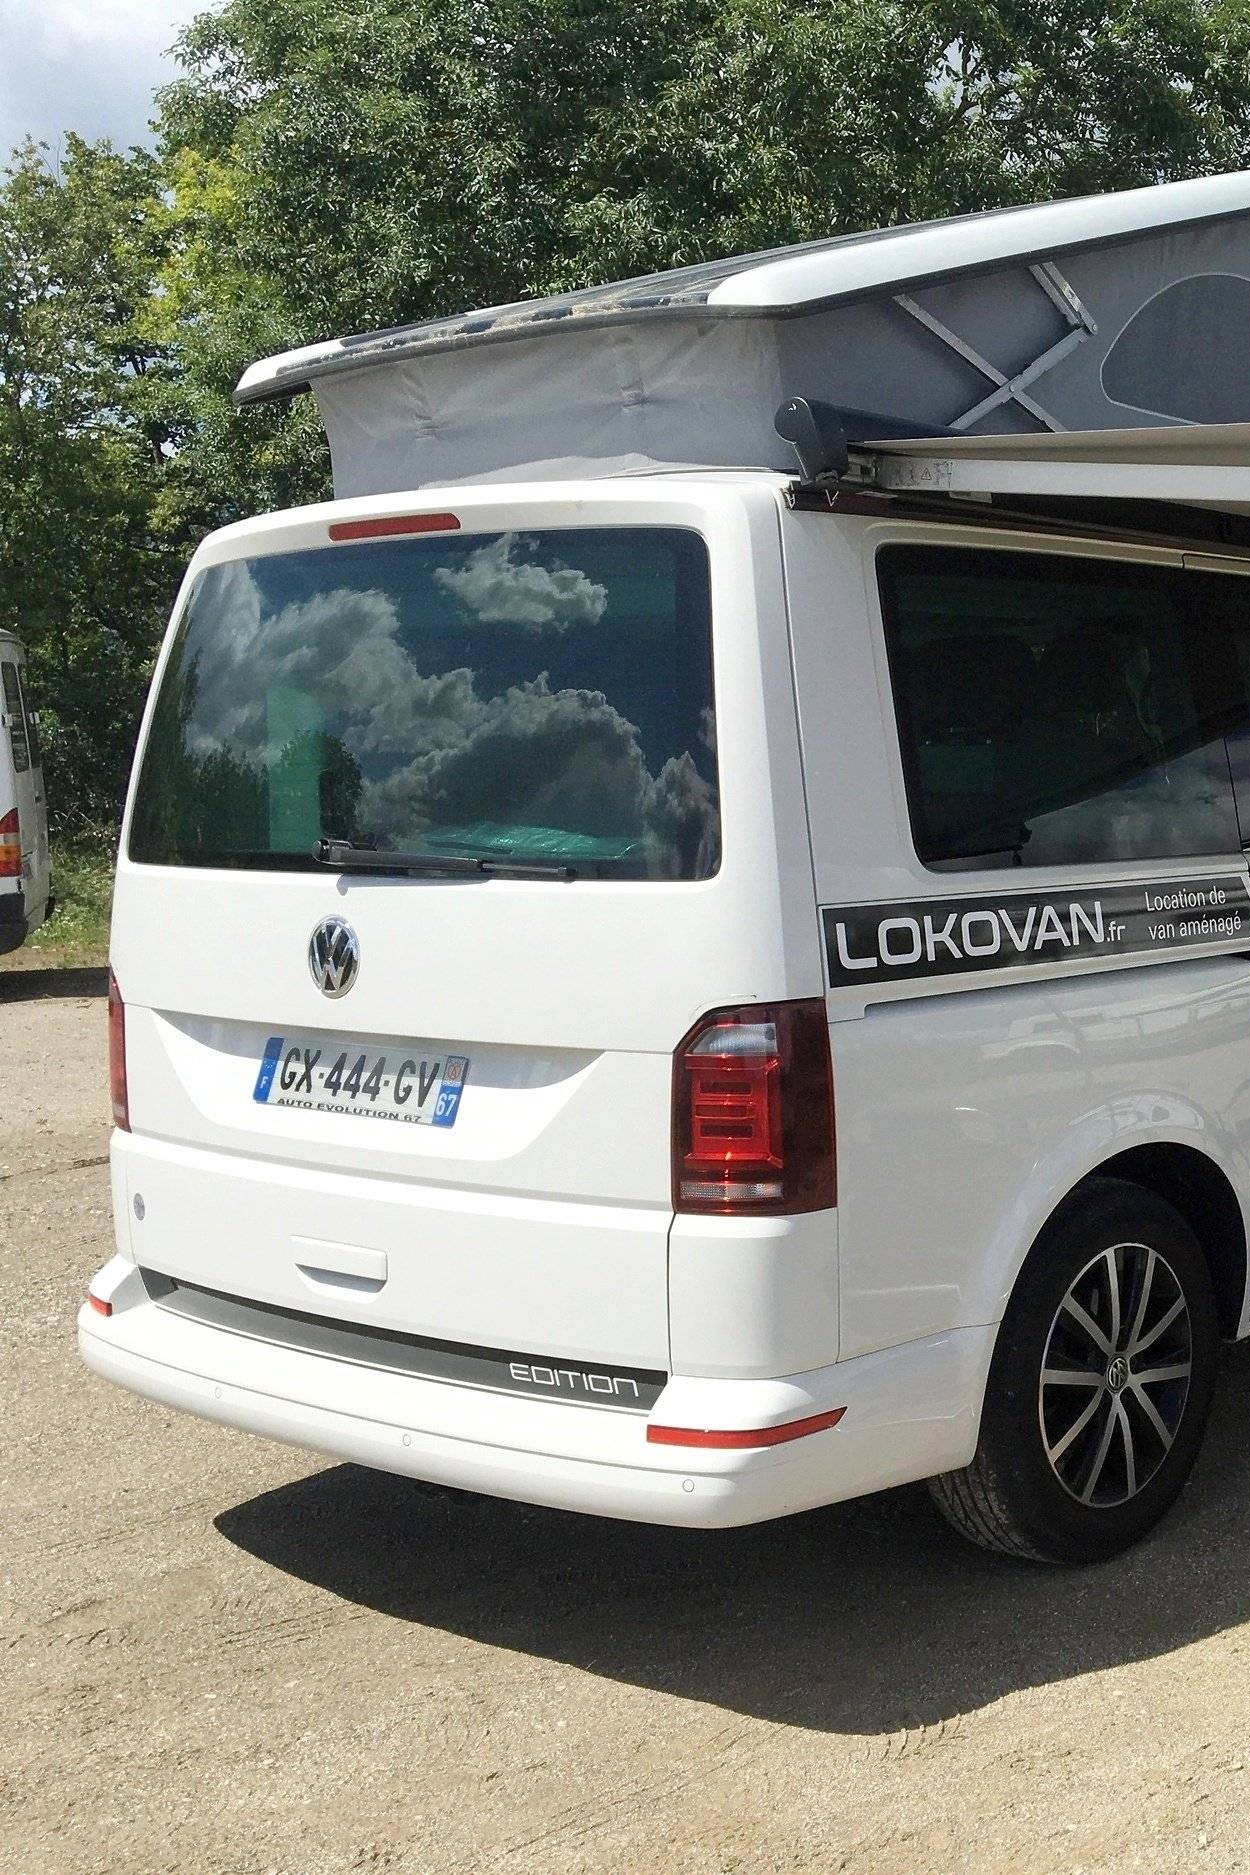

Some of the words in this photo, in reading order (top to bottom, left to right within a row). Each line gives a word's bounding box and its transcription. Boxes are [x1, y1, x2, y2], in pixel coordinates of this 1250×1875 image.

[1144, 888, 1207, 912] Location
[1211, 884, 1227, 905] de
[1147, 922, 1176, 941] van
[1179, 911, 1242, 938] aménagé
[260, 1076, 269, 1089] F
[276, 1097, 313, 1109] AUTO
[317, 1102, 399, 1121] EVOLUTION
[403, 1114, 422, 1123] 67
[435, 1093, 457, 1117] 67
[509, 1362, 639, 1398] EDITION
